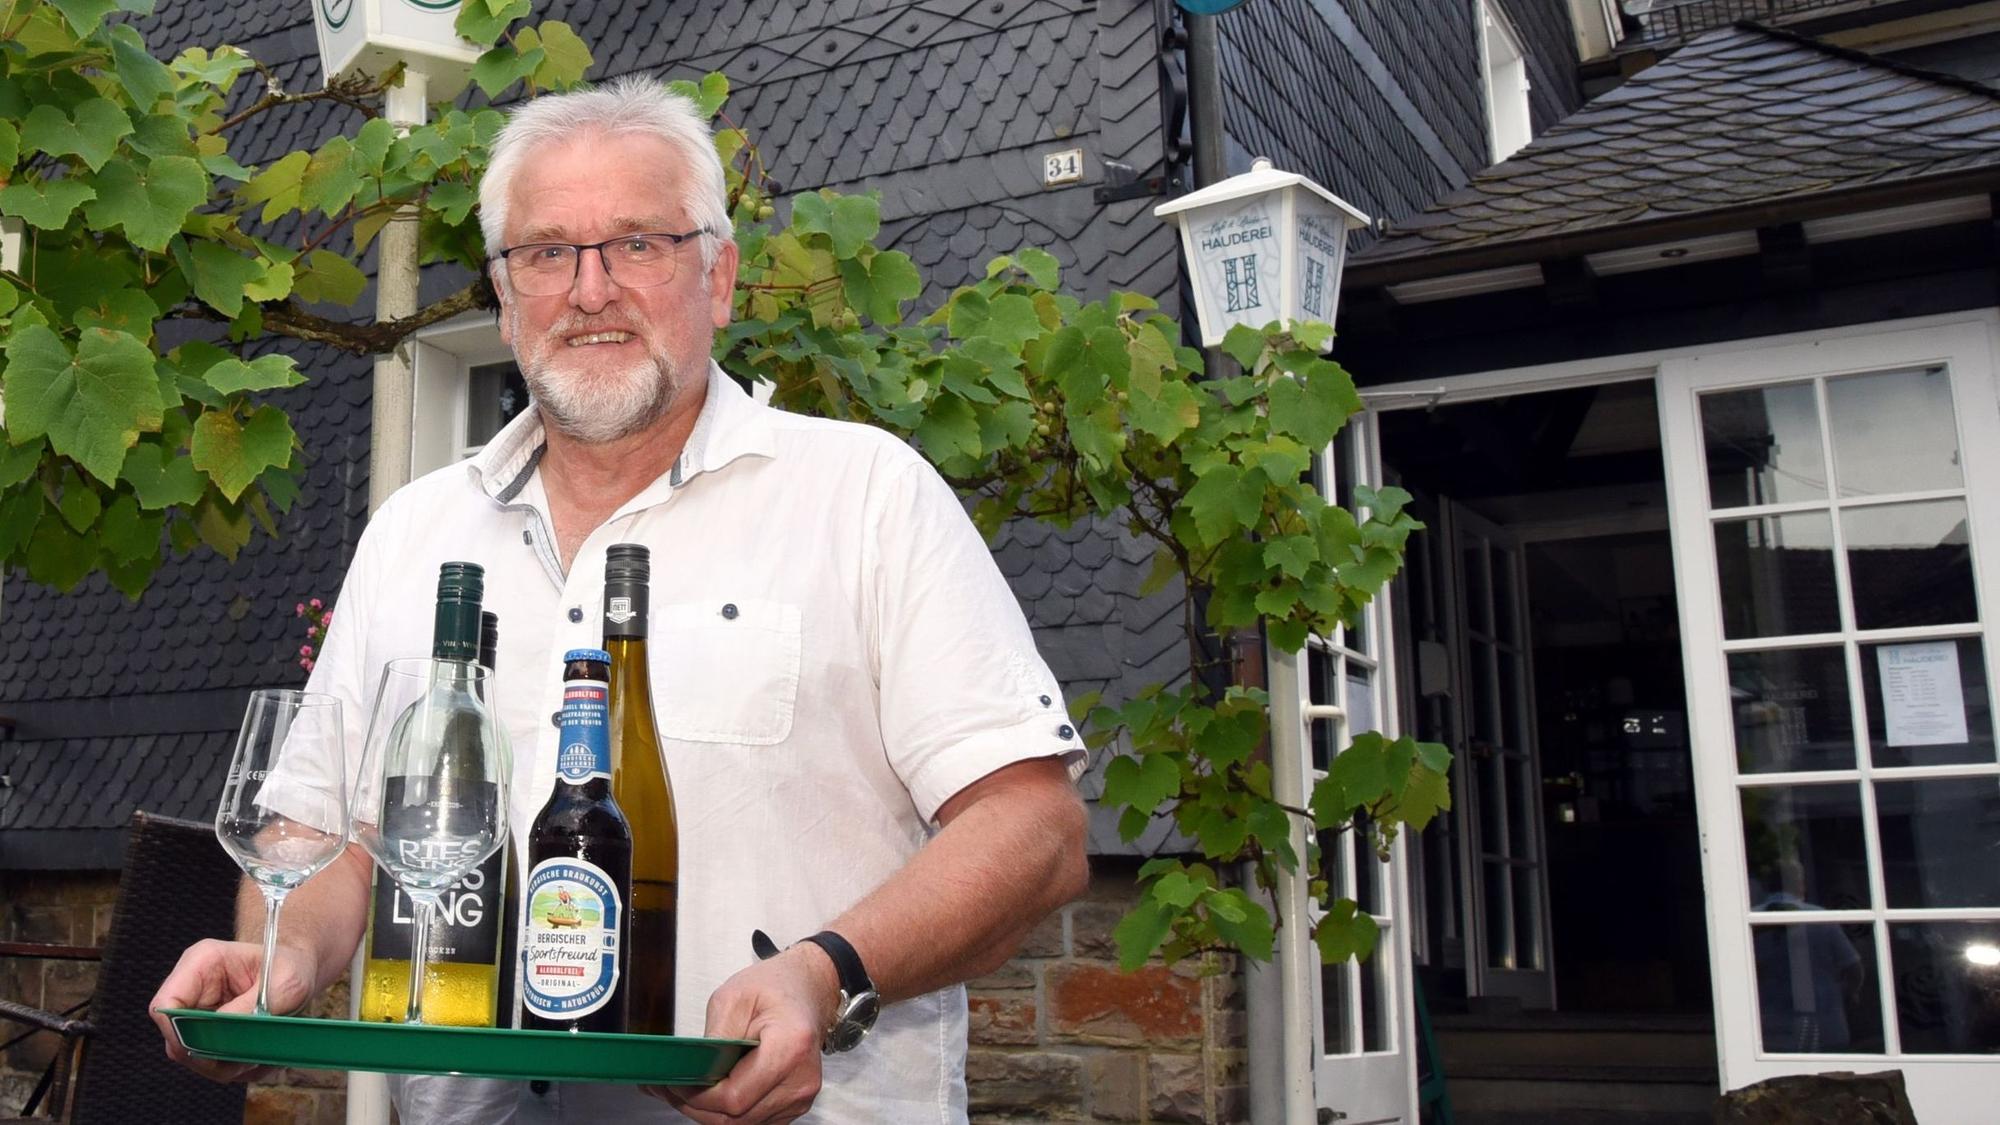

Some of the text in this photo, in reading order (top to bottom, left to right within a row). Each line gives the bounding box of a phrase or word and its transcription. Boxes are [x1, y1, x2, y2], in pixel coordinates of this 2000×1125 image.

[1049, 155, 1078, 177] 34
[1201, 225, 1272, 251] HAUDEREI
[399, 839, 482, 860] RIES
[562, 869, 609, 896] BRAUKUNST
[537, 933, 586, 945] BERGISCHER
[529, 945, 598, 963] Sportsfreund
